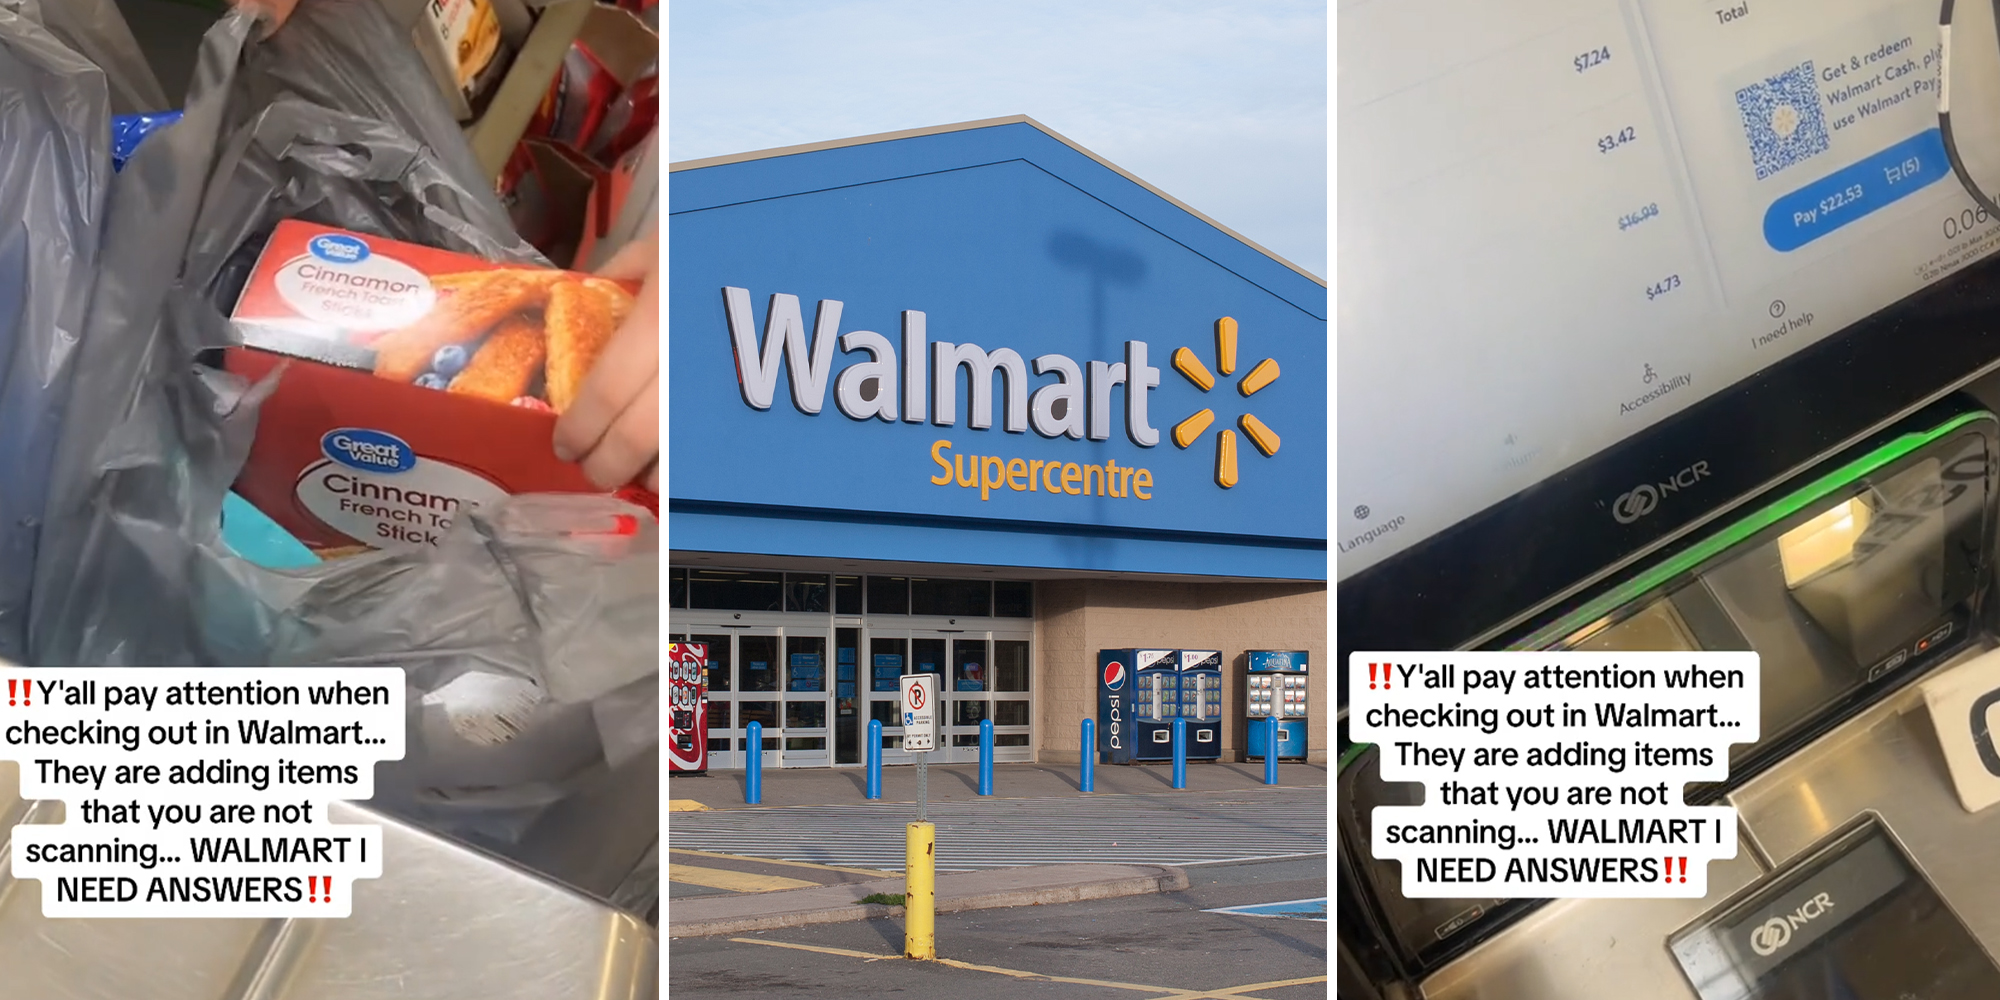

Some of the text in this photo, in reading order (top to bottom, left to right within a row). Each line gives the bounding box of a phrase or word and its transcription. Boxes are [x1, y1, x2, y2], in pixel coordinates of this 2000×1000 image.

[1715, 0, 1748, 24] Total
[1574, 46, 1611, 73] $7.24
[1822, 36, 1913, 82] Get & redeem
[1826, 74, 1882, 106] Walmart
[1833, 77, 1936, 130] use Walmart Pay
[1598, 126, 1636, 154] $3.42
[1793, 156, 1920, 227] Pay $22.53 (5)
[316, 238, 360, 254] Great
[297, 263, 419, 295] Cinnamon
[301, 281, 357, 300] French
[1646, 274, 1681, 300] $4.73
[1759, 322, 1788, 346] need
[1788, 312, 1815, 333] help
[721, 286, 1160, 447] Walmart
[1619, 372, 1692, 416] Accessibility
[333, 435, 400, 458] Great
[350, 450, 400, 468] Value
[931, 439, 1154, 501] Supercentre
[1658, 460, 1711, 498] NCR
[323, 474, 463, 512] Cinnam
[340, 498, 422, 524] French
[376, 522, 439, 547] Stick
[1337, 515, 1406, 553] Language
[1108, 695, 1122, 750] pepsi
[1786, 892, 1835, 930] NCR
